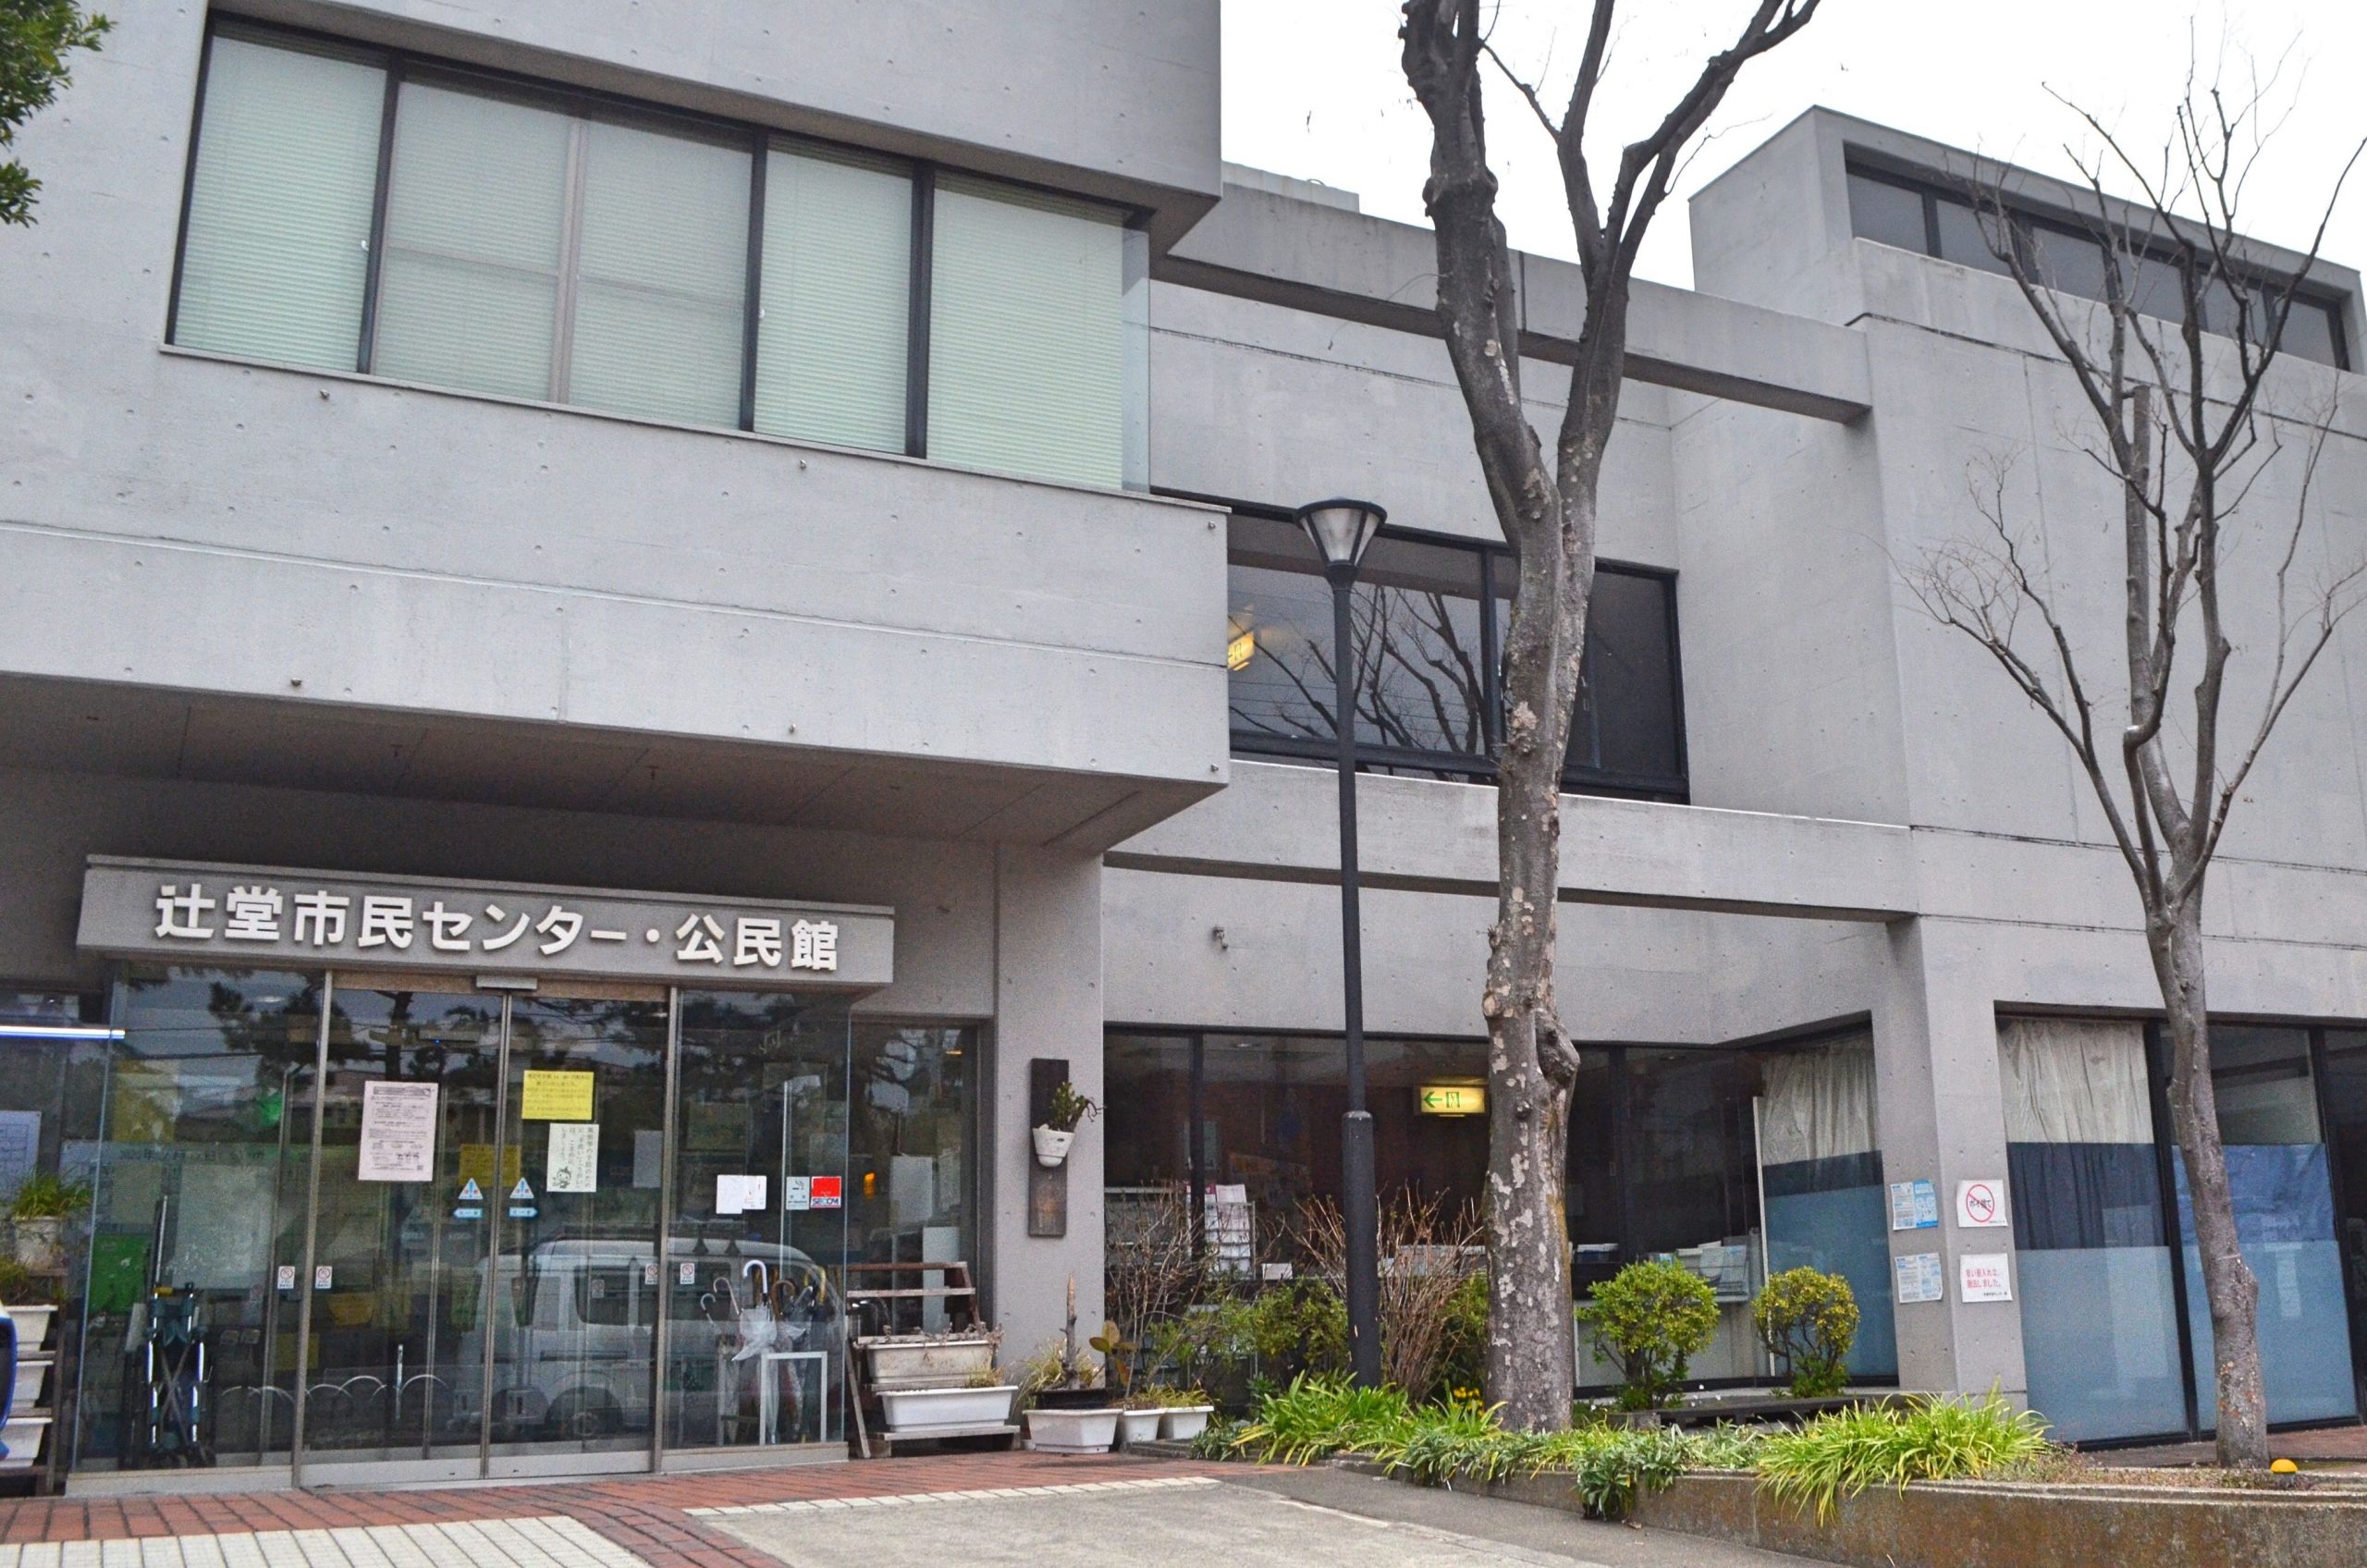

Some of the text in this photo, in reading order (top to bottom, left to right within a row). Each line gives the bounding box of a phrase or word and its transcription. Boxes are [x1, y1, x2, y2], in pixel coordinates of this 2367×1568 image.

[155, 884, 840, 972] 辻堂市民センター・公民館
